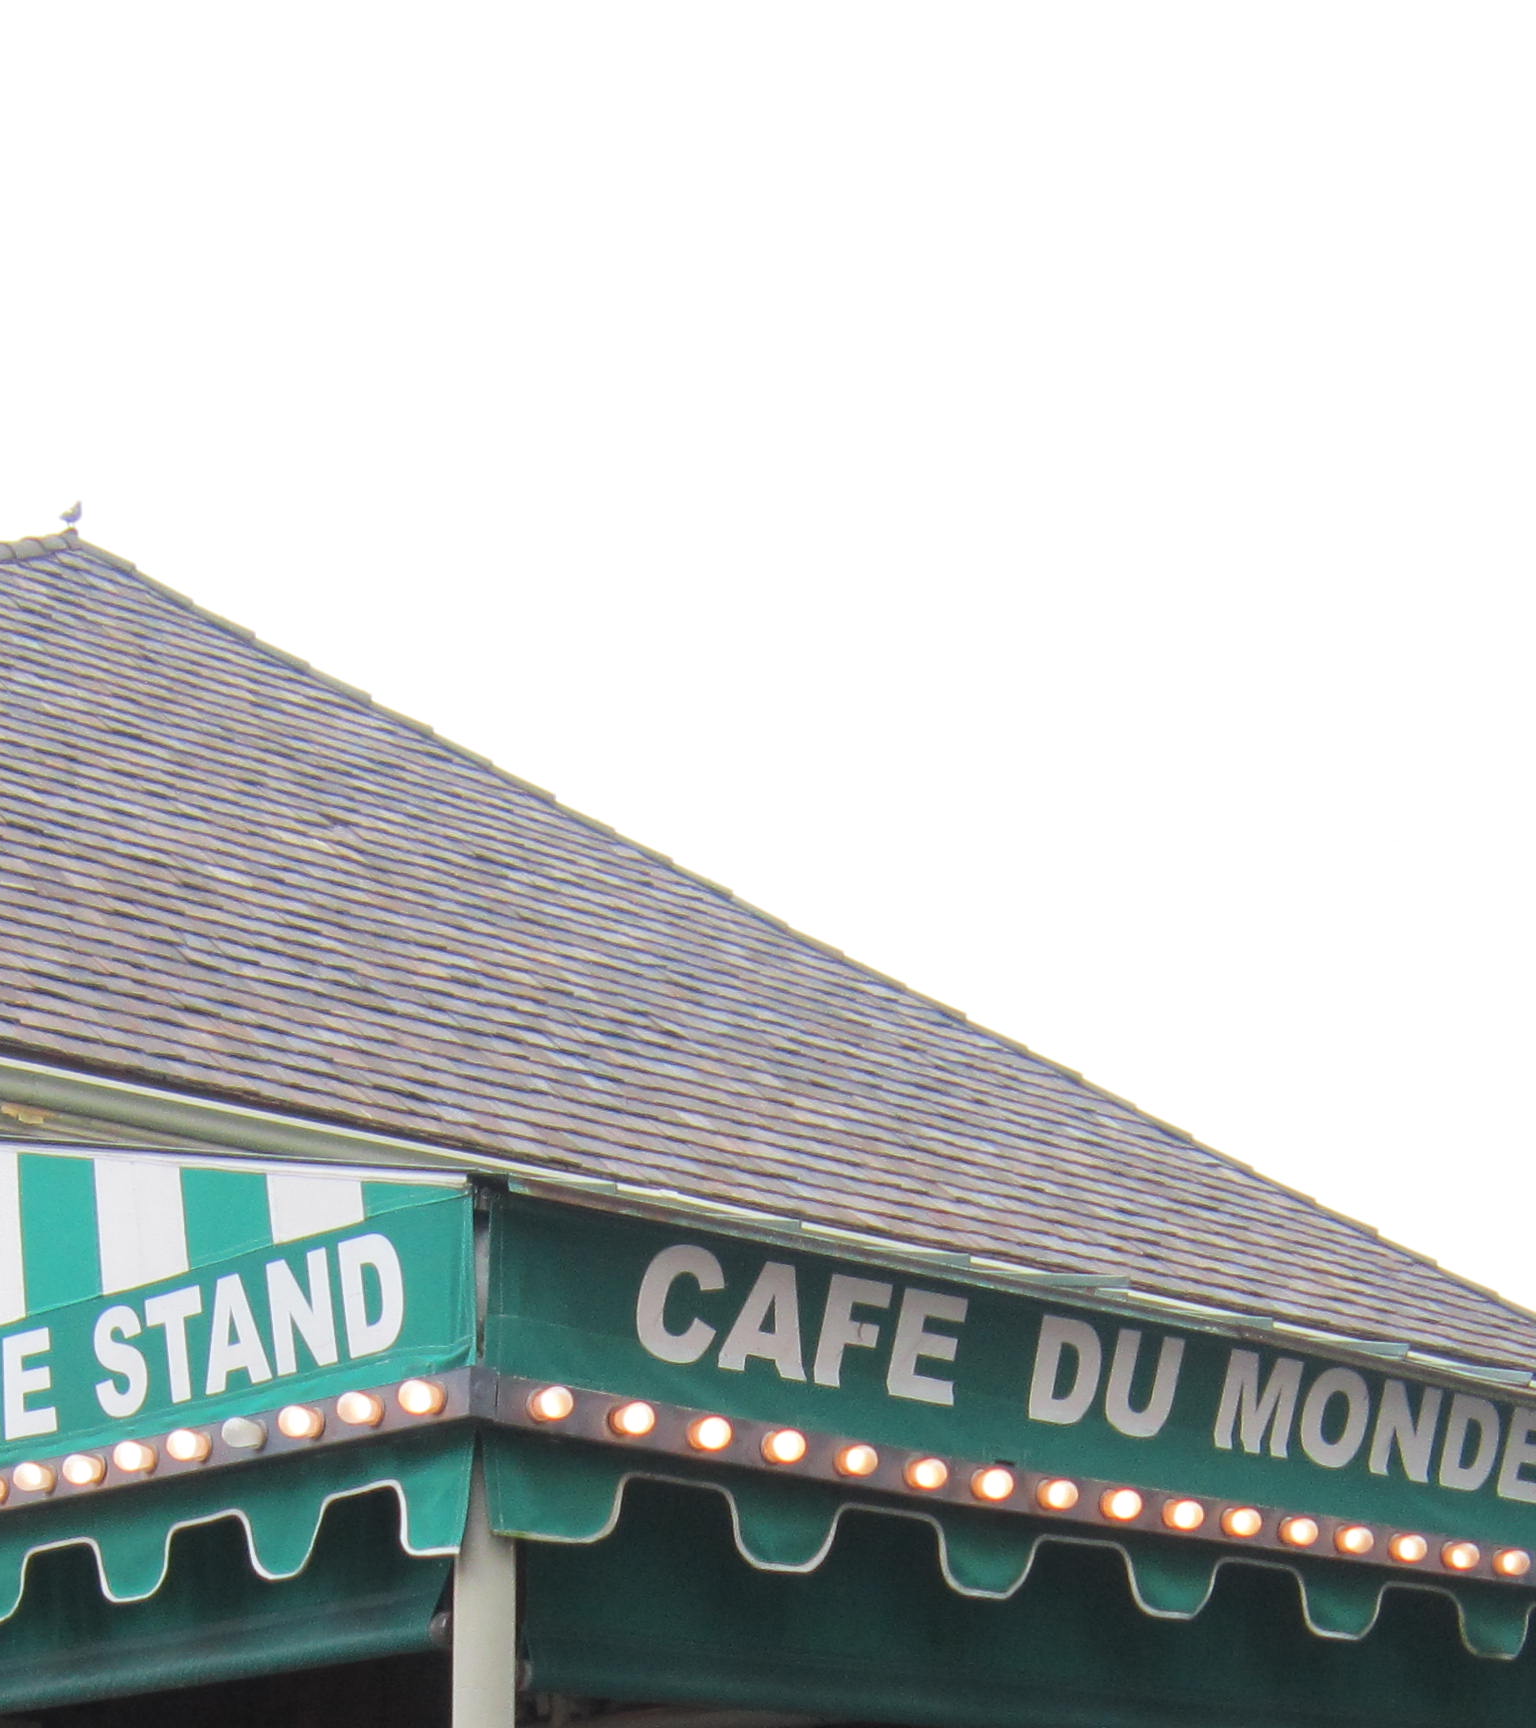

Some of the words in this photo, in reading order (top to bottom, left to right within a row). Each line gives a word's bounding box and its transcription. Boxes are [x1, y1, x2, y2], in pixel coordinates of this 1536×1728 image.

[91, 1233, 405, 1417] STAND
[635, 1243, 968, 1405] CAFE
[1027, 1314, 1185, 1439] DU
